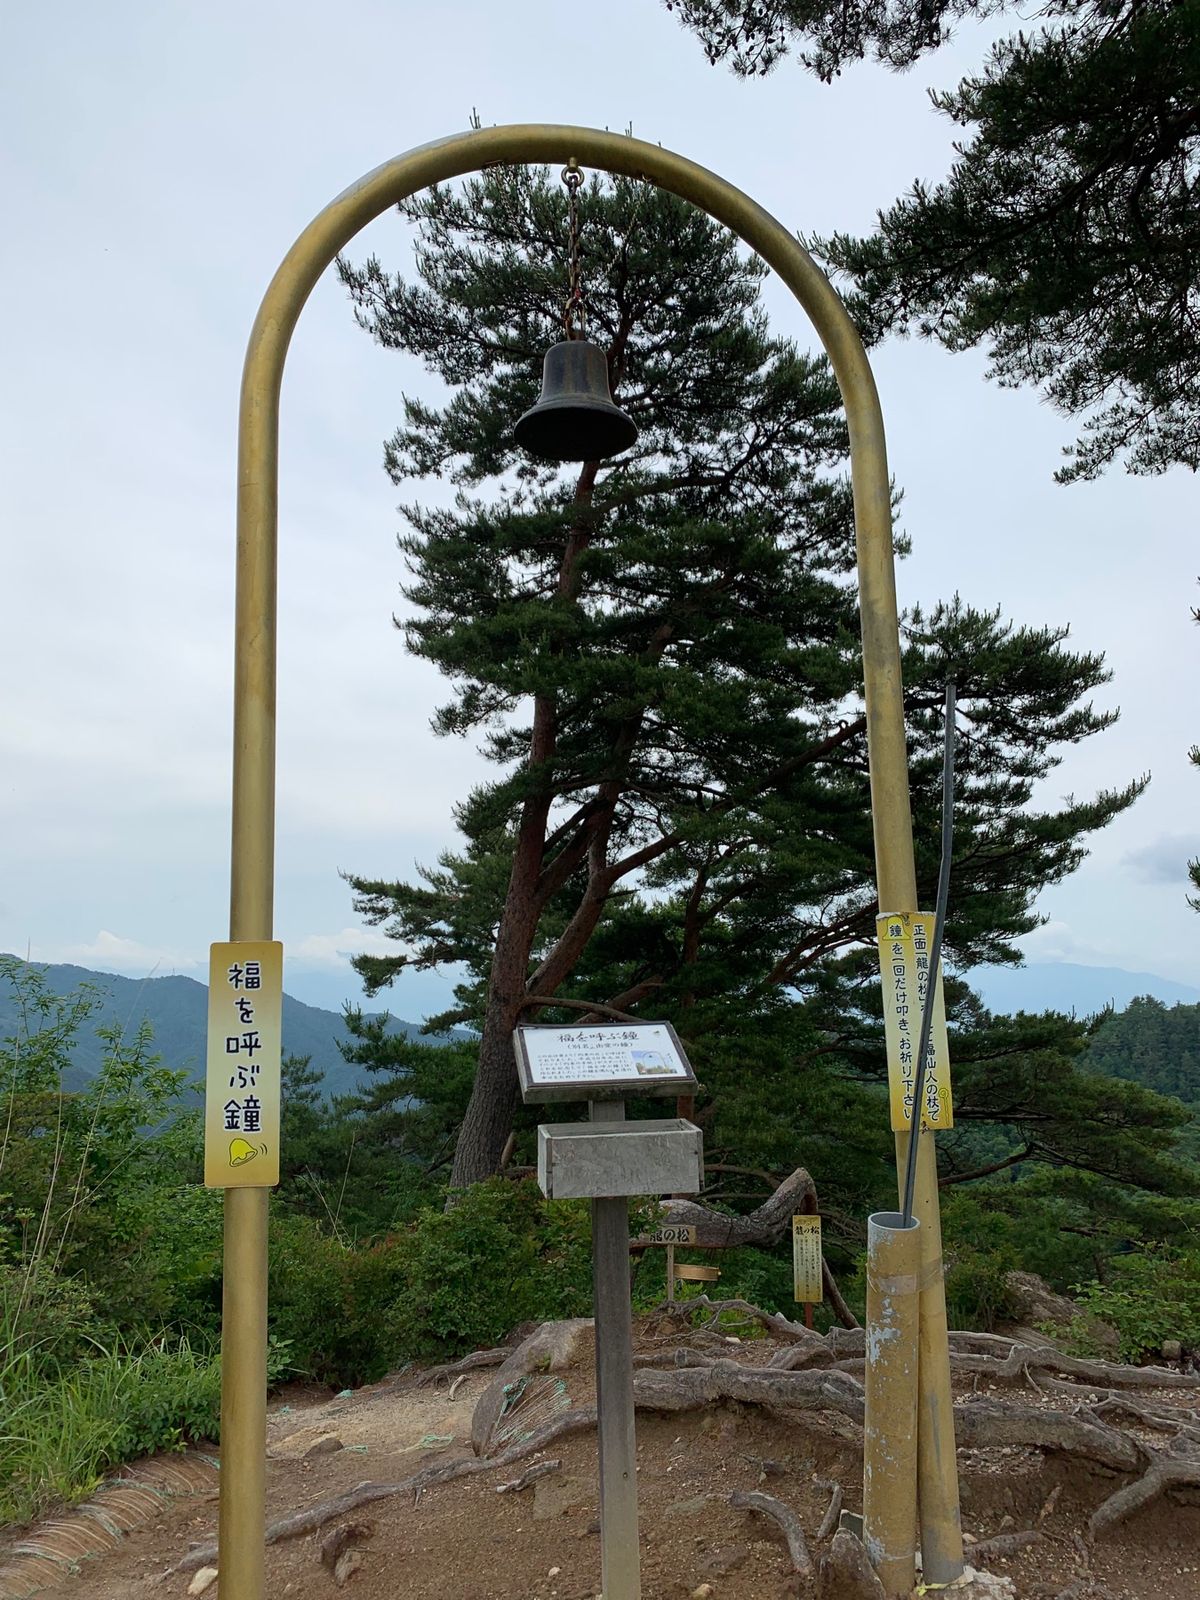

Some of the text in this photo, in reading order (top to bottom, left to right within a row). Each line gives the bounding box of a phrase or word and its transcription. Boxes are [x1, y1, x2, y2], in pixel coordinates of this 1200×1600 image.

[223, 962, 262, 1133] 福を呼ぶ鐘
